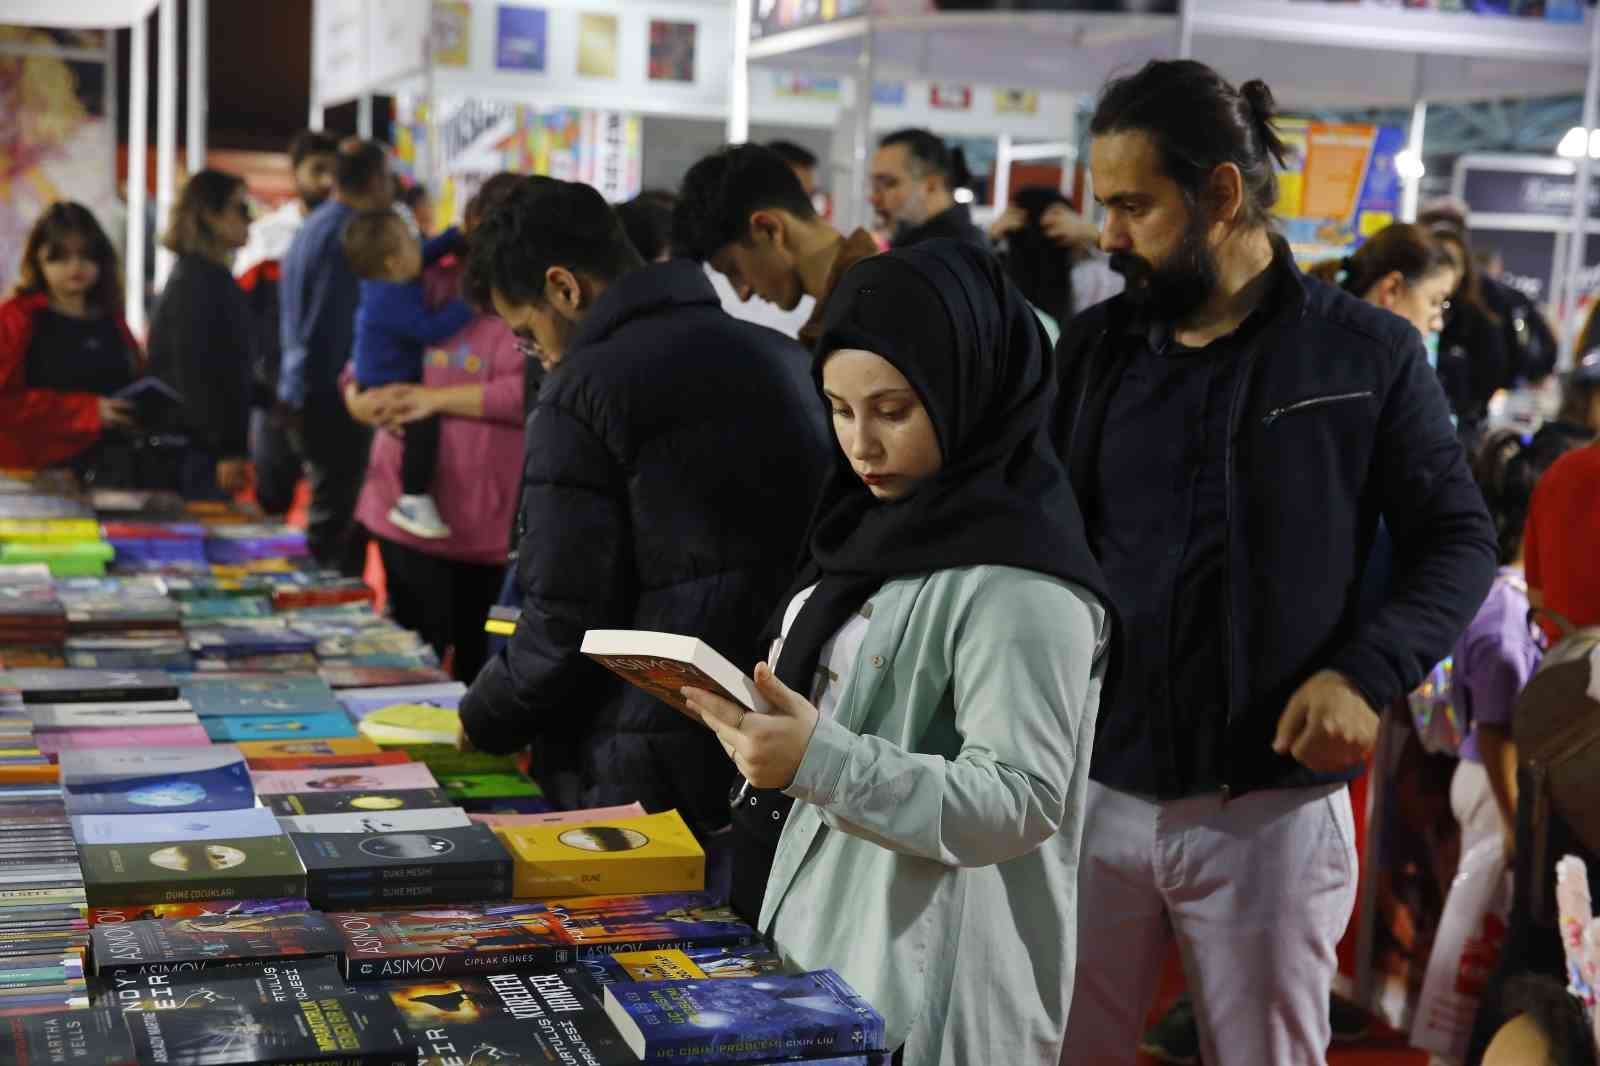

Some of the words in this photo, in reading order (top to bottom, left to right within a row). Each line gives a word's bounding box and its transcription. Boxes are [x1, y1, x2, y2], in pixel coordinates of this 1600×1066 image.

[103, 924, 144, 960] ASIMOV
[337, 911, 388, 955] ASIMOV
[381, 956, 446, 975] ASIMOV
[115, 978, 143, 1011] NDY
[147, 974, 177, 1009] EIR
[486, 974, 546, 1019] KÖRELTEN
[528, 974, 585, 1012] HANÇER
[44, 1018, 65, 1062] MARTHA
[67, 1020, 88, 1056] WELLS
[425, 1028, 466, 1066] EIR
